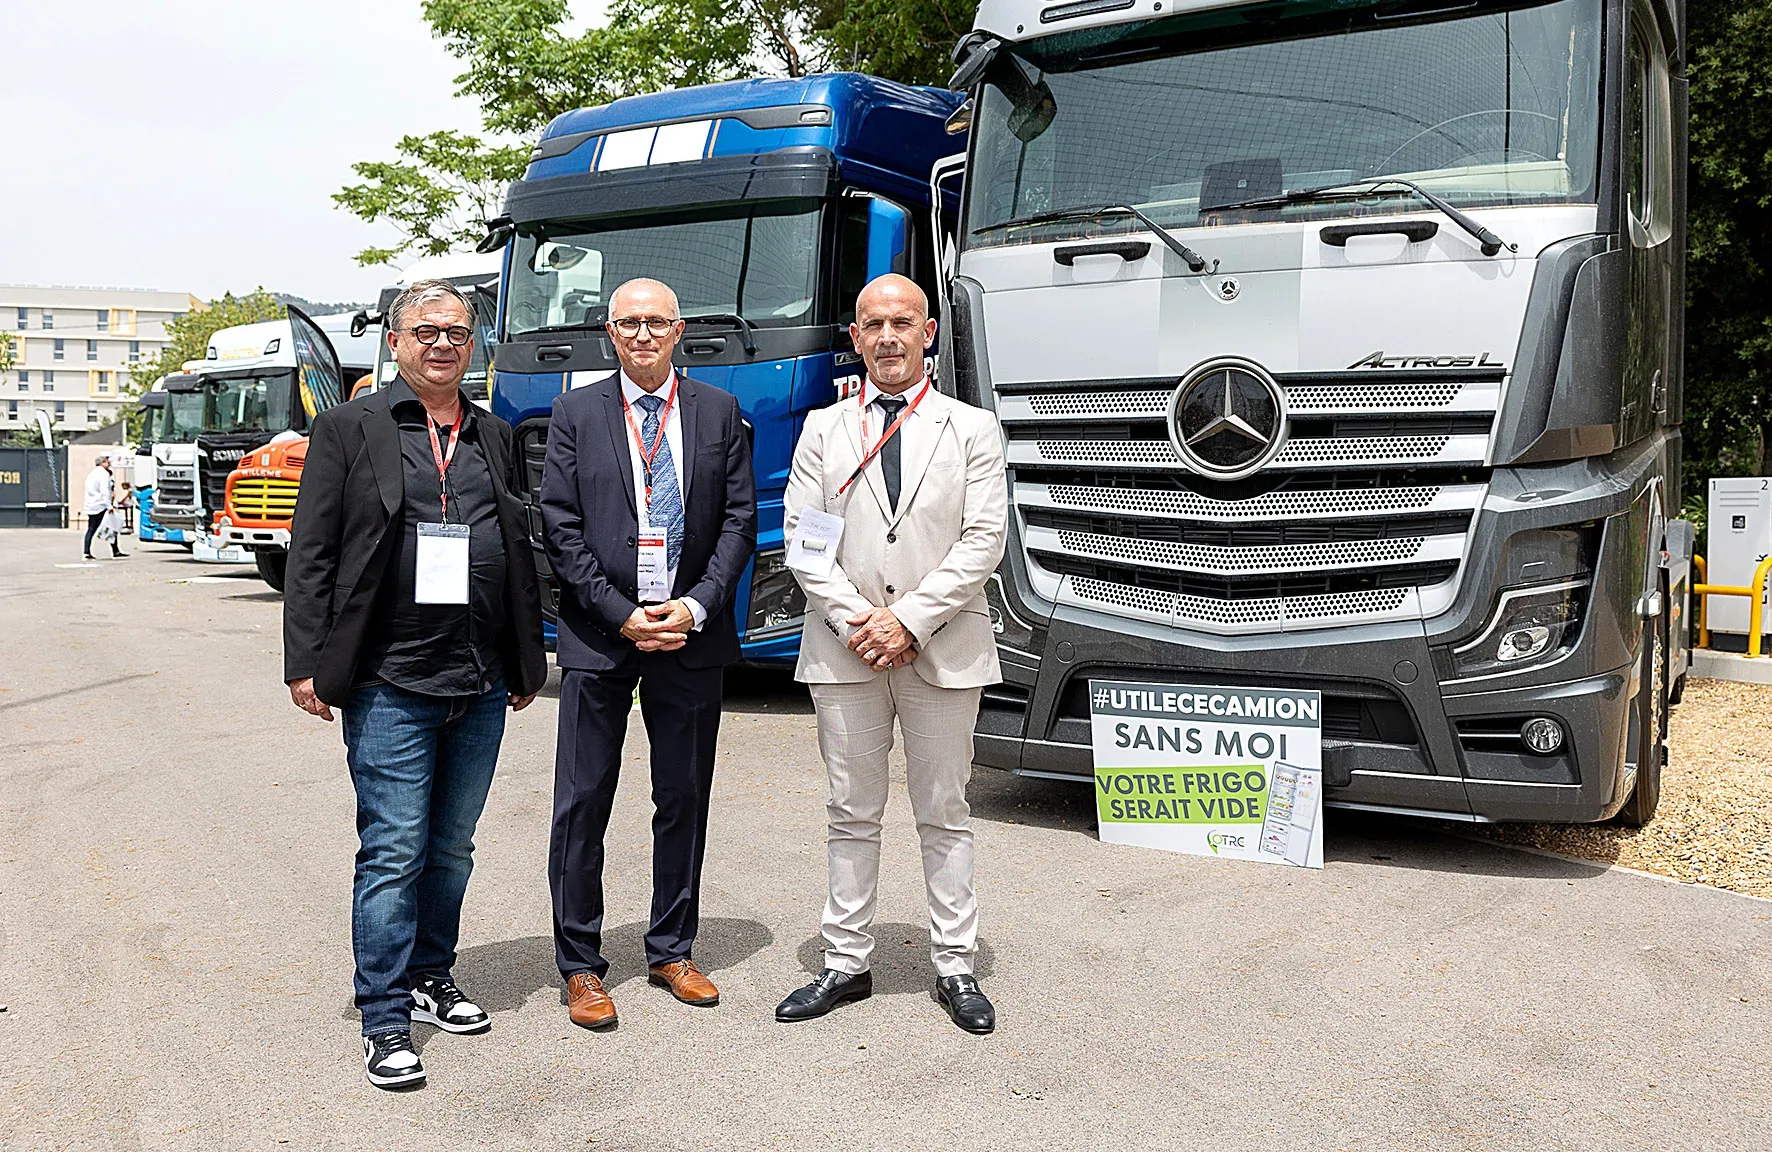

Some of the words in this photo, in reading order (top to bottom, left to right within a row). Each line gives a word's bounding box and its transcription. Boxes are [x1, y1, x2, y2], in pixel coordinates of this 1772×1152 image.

[1347, 351, 1476, 369] ACTROS
[1478, 352, 1504, 367] L
[166, 470, 186, 478] DAF
[1712, 481, 1717, 491] 1
[1761, 479, 1769, 490] 2
[1093, 688, 1318, 720] #UTILECECAMION
[1115, 723, 1202, 754] SANS
[1215, 730, 1287, 760] MOI
[1096, 773, 1176, 795] VOTRE
[1184, 771, 1266, 794] FRIGO
[1111, 799, 1191, 819] SERAIT
[1197, 797, 1261, 819] VIDE
